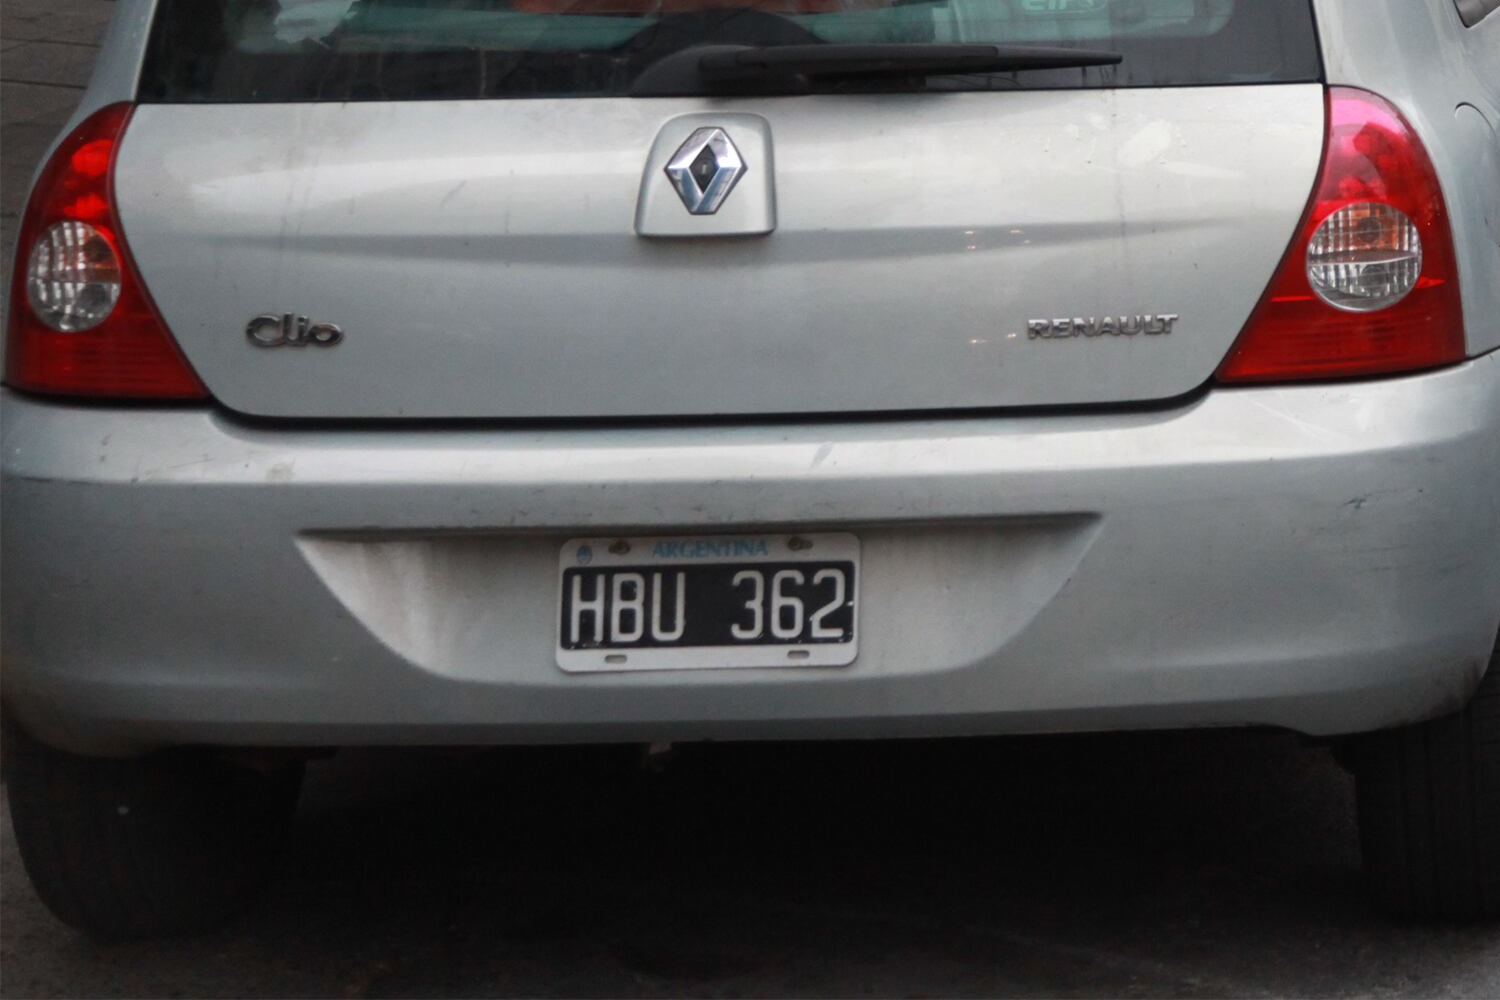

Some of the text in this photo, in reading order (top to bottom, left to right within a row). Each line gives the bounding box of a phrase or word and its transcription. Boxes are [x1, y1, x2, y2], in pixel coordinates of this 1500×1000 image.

[246, 312, 344, 349] Clio
[1027, 314, 1178, 339] RENAULT
[652, 540, 769, 559] ARGENTINA
[569, 568, 845, 643] HBU 362
